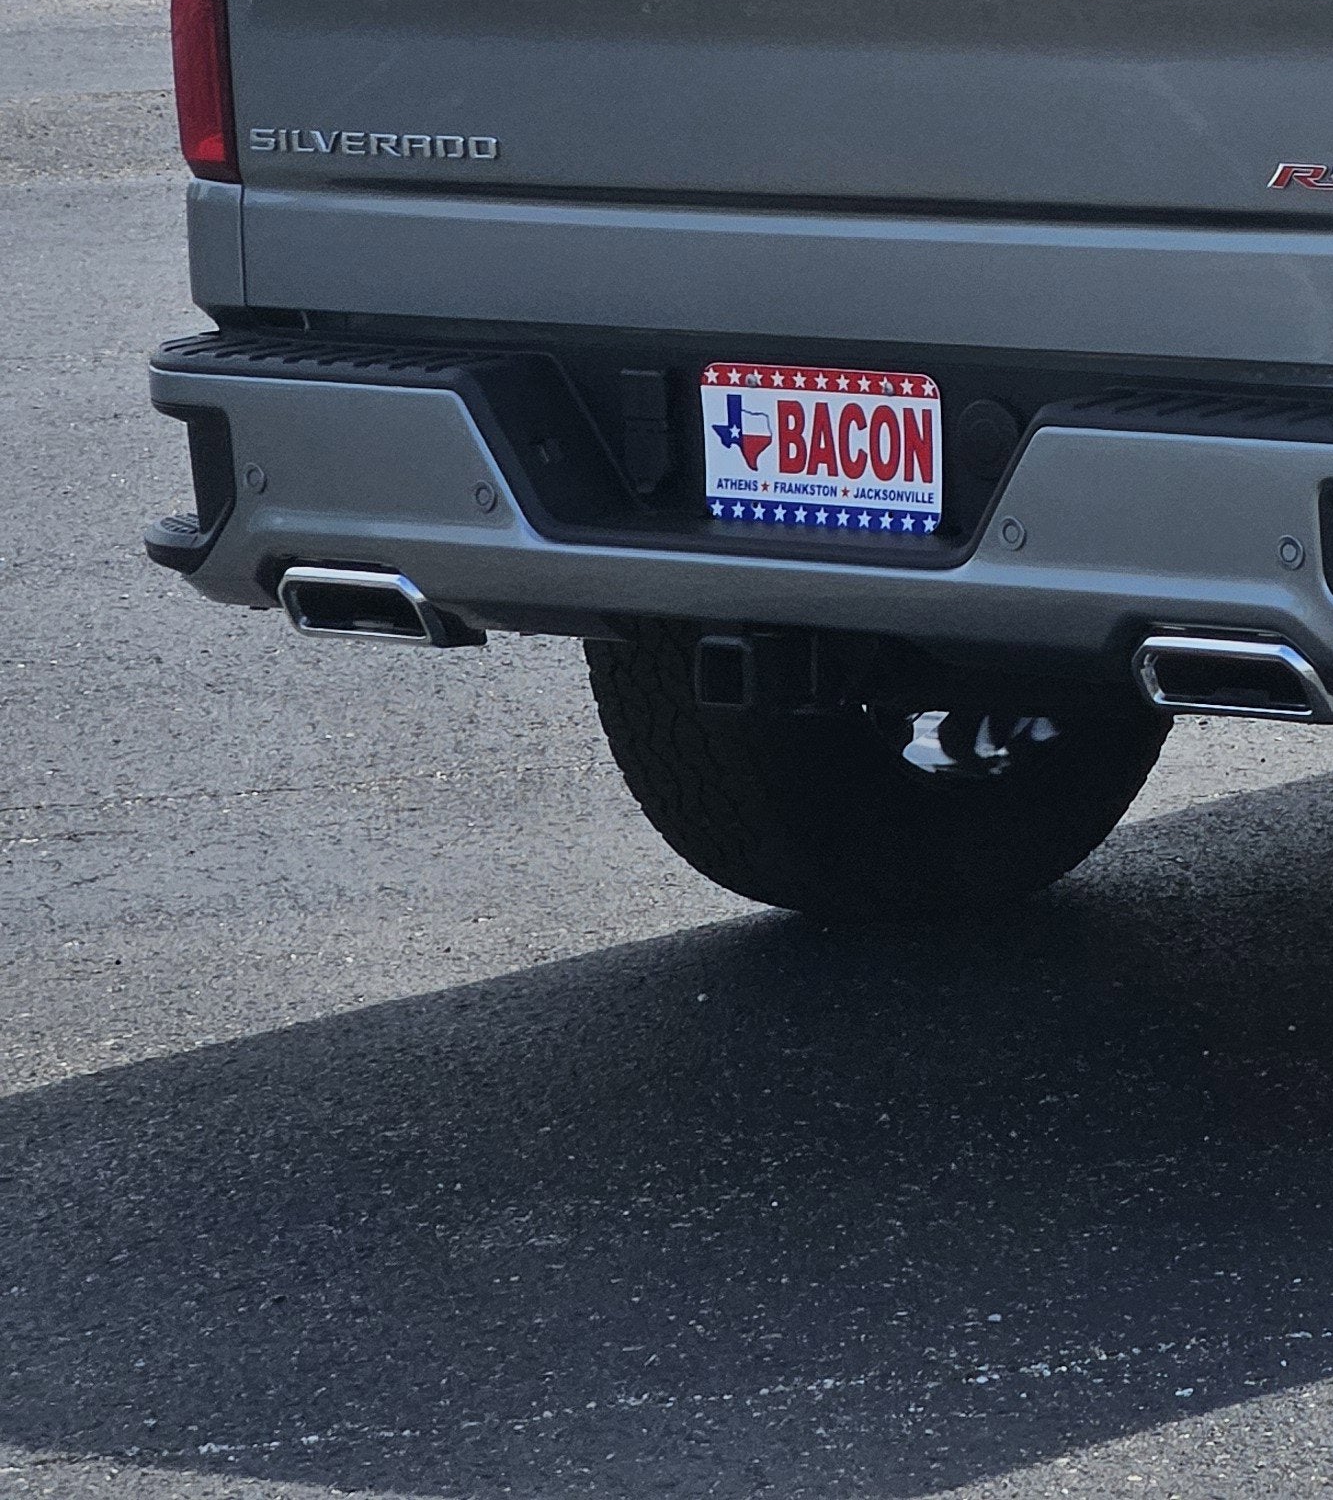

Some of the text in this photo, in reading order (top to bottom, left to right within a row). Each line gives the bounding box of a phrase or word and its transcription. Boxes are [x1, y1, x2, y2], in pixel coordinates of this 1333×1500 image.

[249, 127, 499, 160] SILVERADO
[777, 400, 933, 483] BACON
[716, 477, 935, 504] ATHENS FRANKSTON JACKSONVILLE
